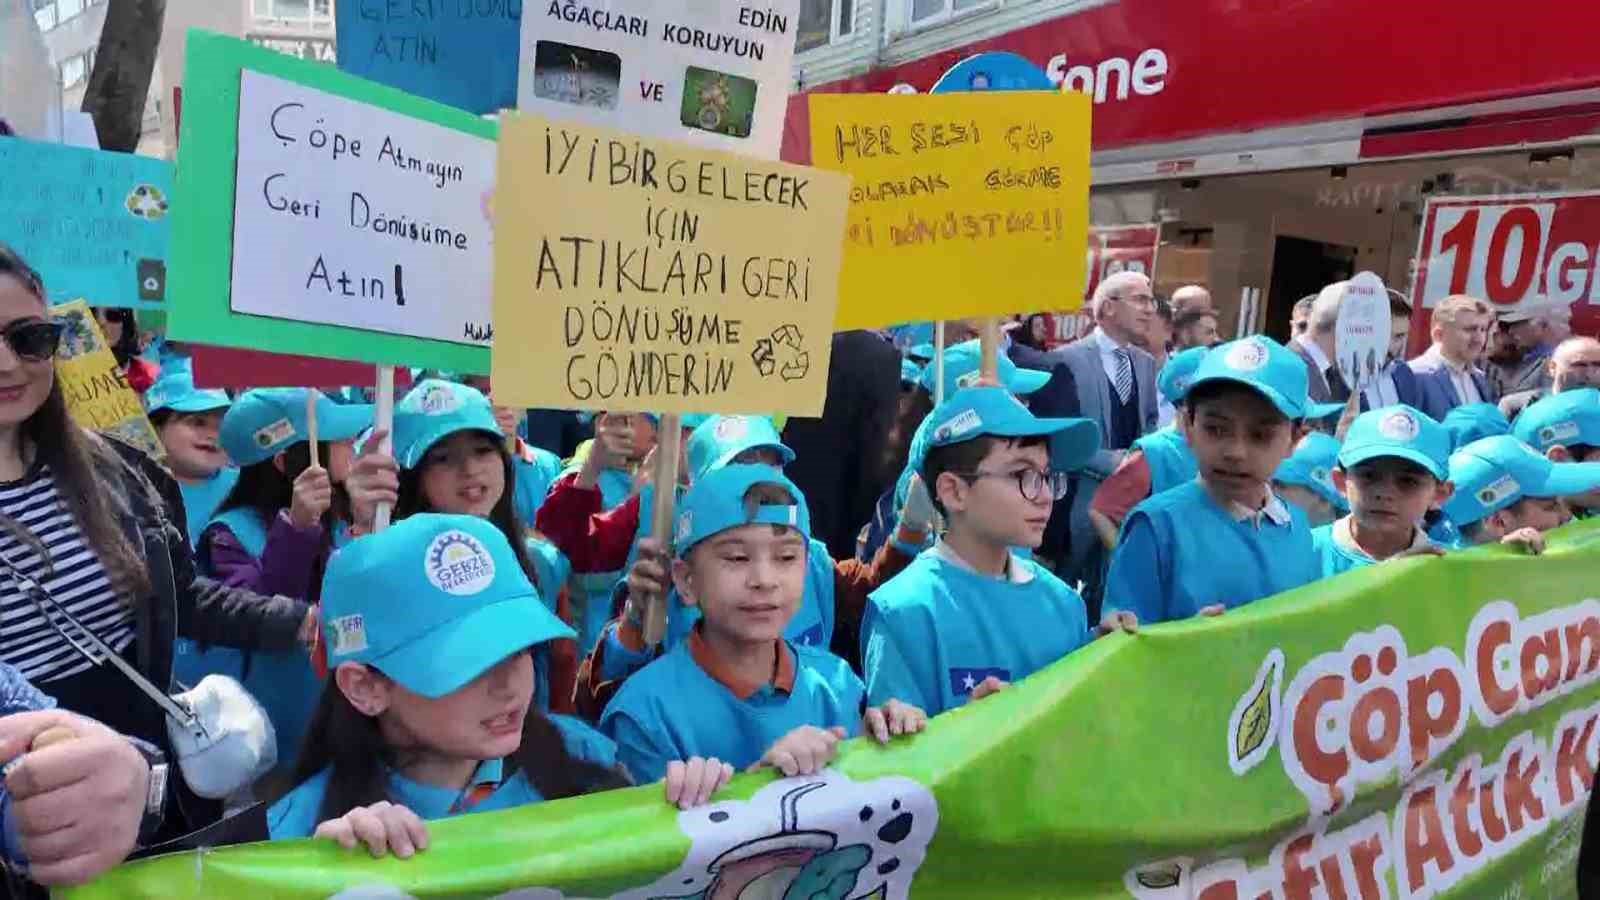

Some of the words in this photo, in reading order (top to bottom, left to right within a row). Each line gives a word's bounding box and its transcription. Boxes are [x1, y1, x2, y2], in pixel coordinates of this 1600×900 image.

[548, 0, 648, 37] AĞAÇLARI
[663, 23, 764, 61] KORUYUN
[739, 7, 788, 34] EDİN
[640, 80, 664, 102] VE
[271, 102, 362, 160] Çöpe
[377, 135, 463, 188] Atmayın
[545, 127, 599, 183] İYİ
[609, 141, 658, 189] BİR
[666, 159, 810, 211] GELECEK
[264, 173, 321, 219] Geri
[306, 254, 406, 307] Atın!
[536, 237, 728, 296] ATIKLARI
[742, 255, 812, 303] GERİ
[565, 299, 742, 348] DÖNÜŞÜME
[566, 345, 735, 401] GÖNDERİN
[437, 555, 489, 581] GEBZE
[1292, 645, 1461, 816] Çöp
[1403, 745, 1545, 896] Atık
